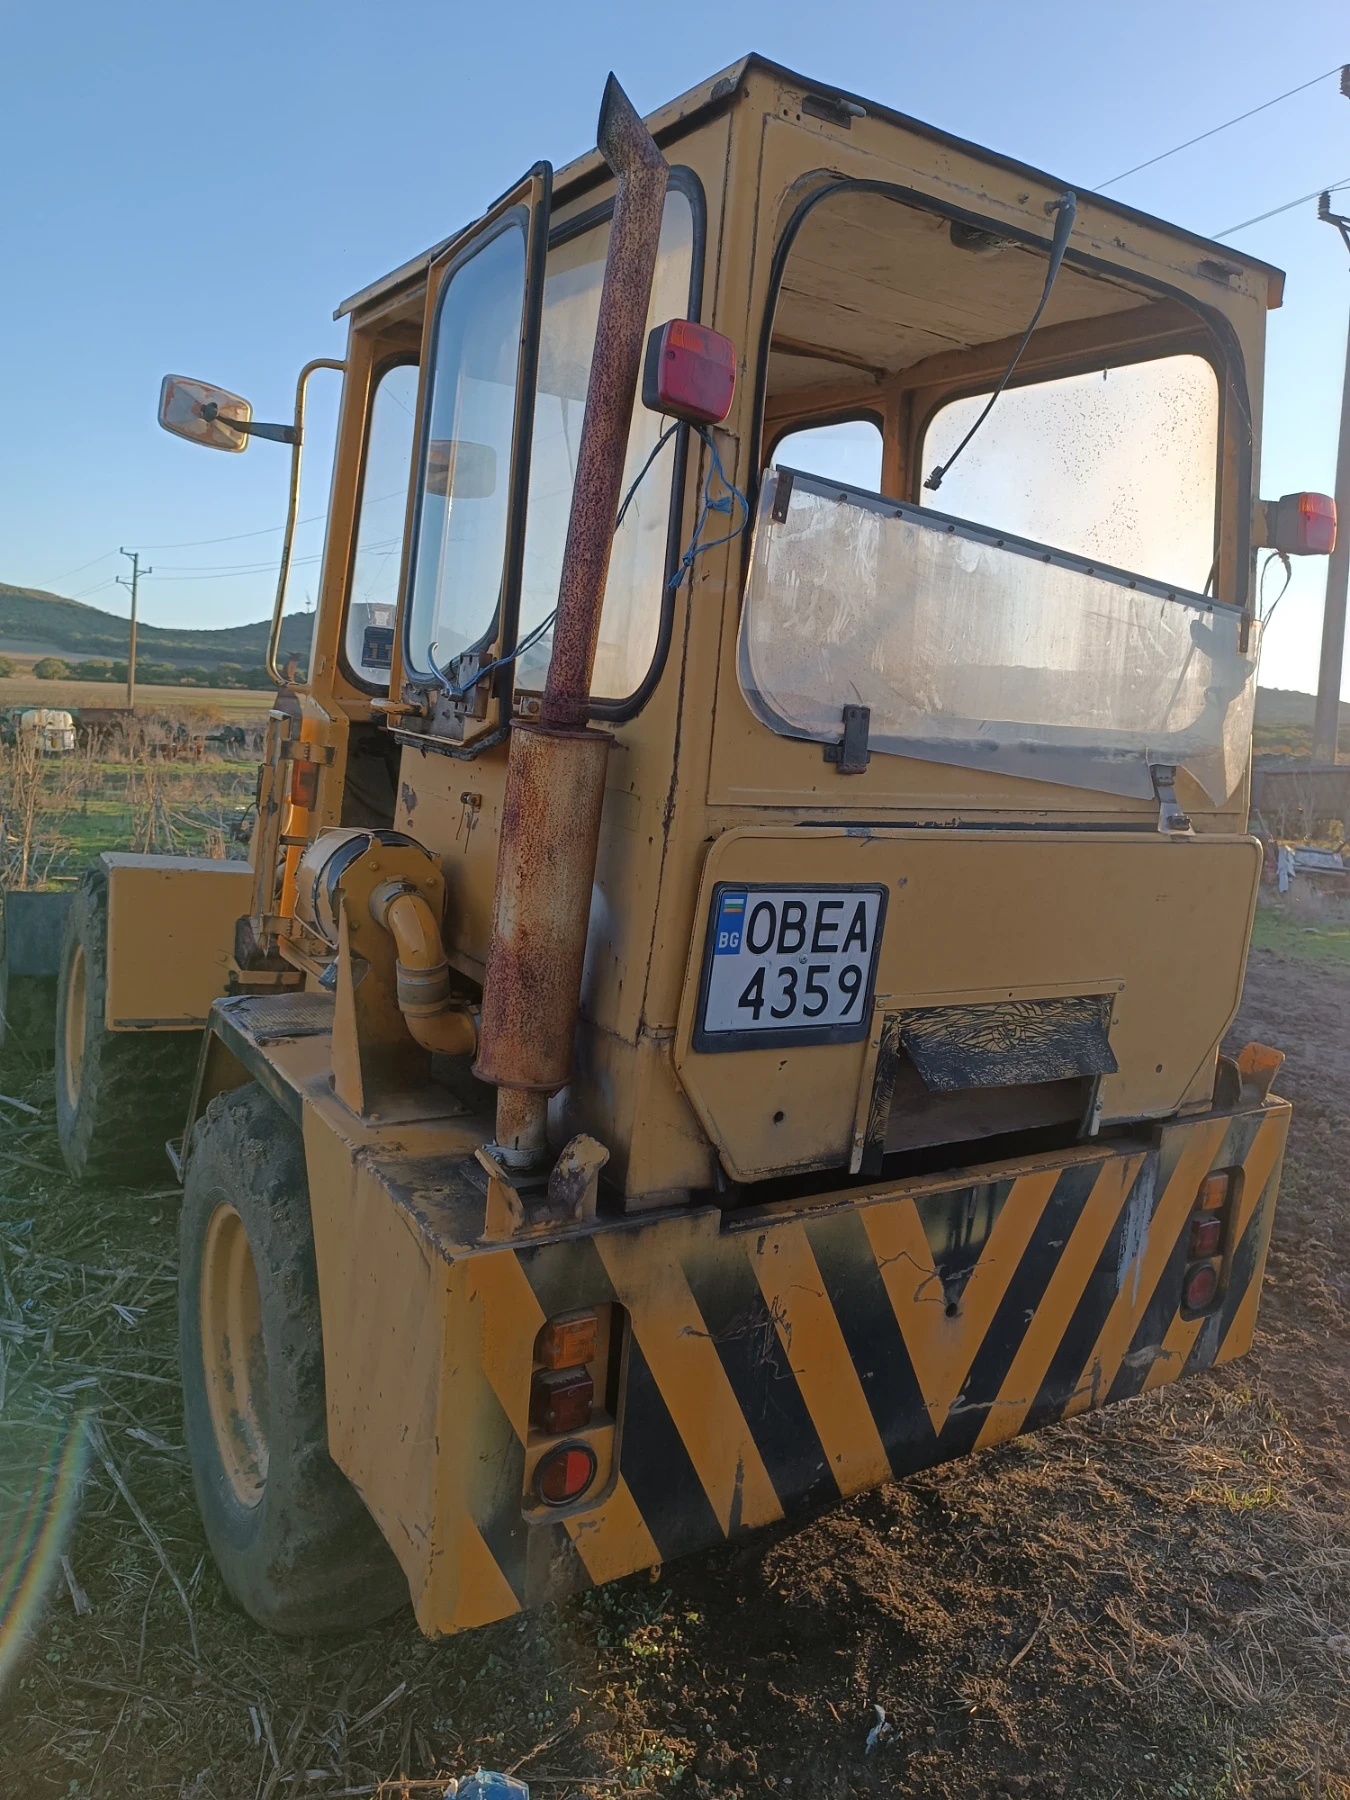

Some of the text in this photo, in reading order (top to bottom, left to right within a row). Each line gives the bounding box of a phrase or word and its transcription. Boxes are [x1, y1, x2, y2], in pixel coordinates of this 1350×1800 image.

[718, 932, 739, 949] BG
[746, 901, 867, 954] OBEA
[738, 964, 862, 1020] 4359
